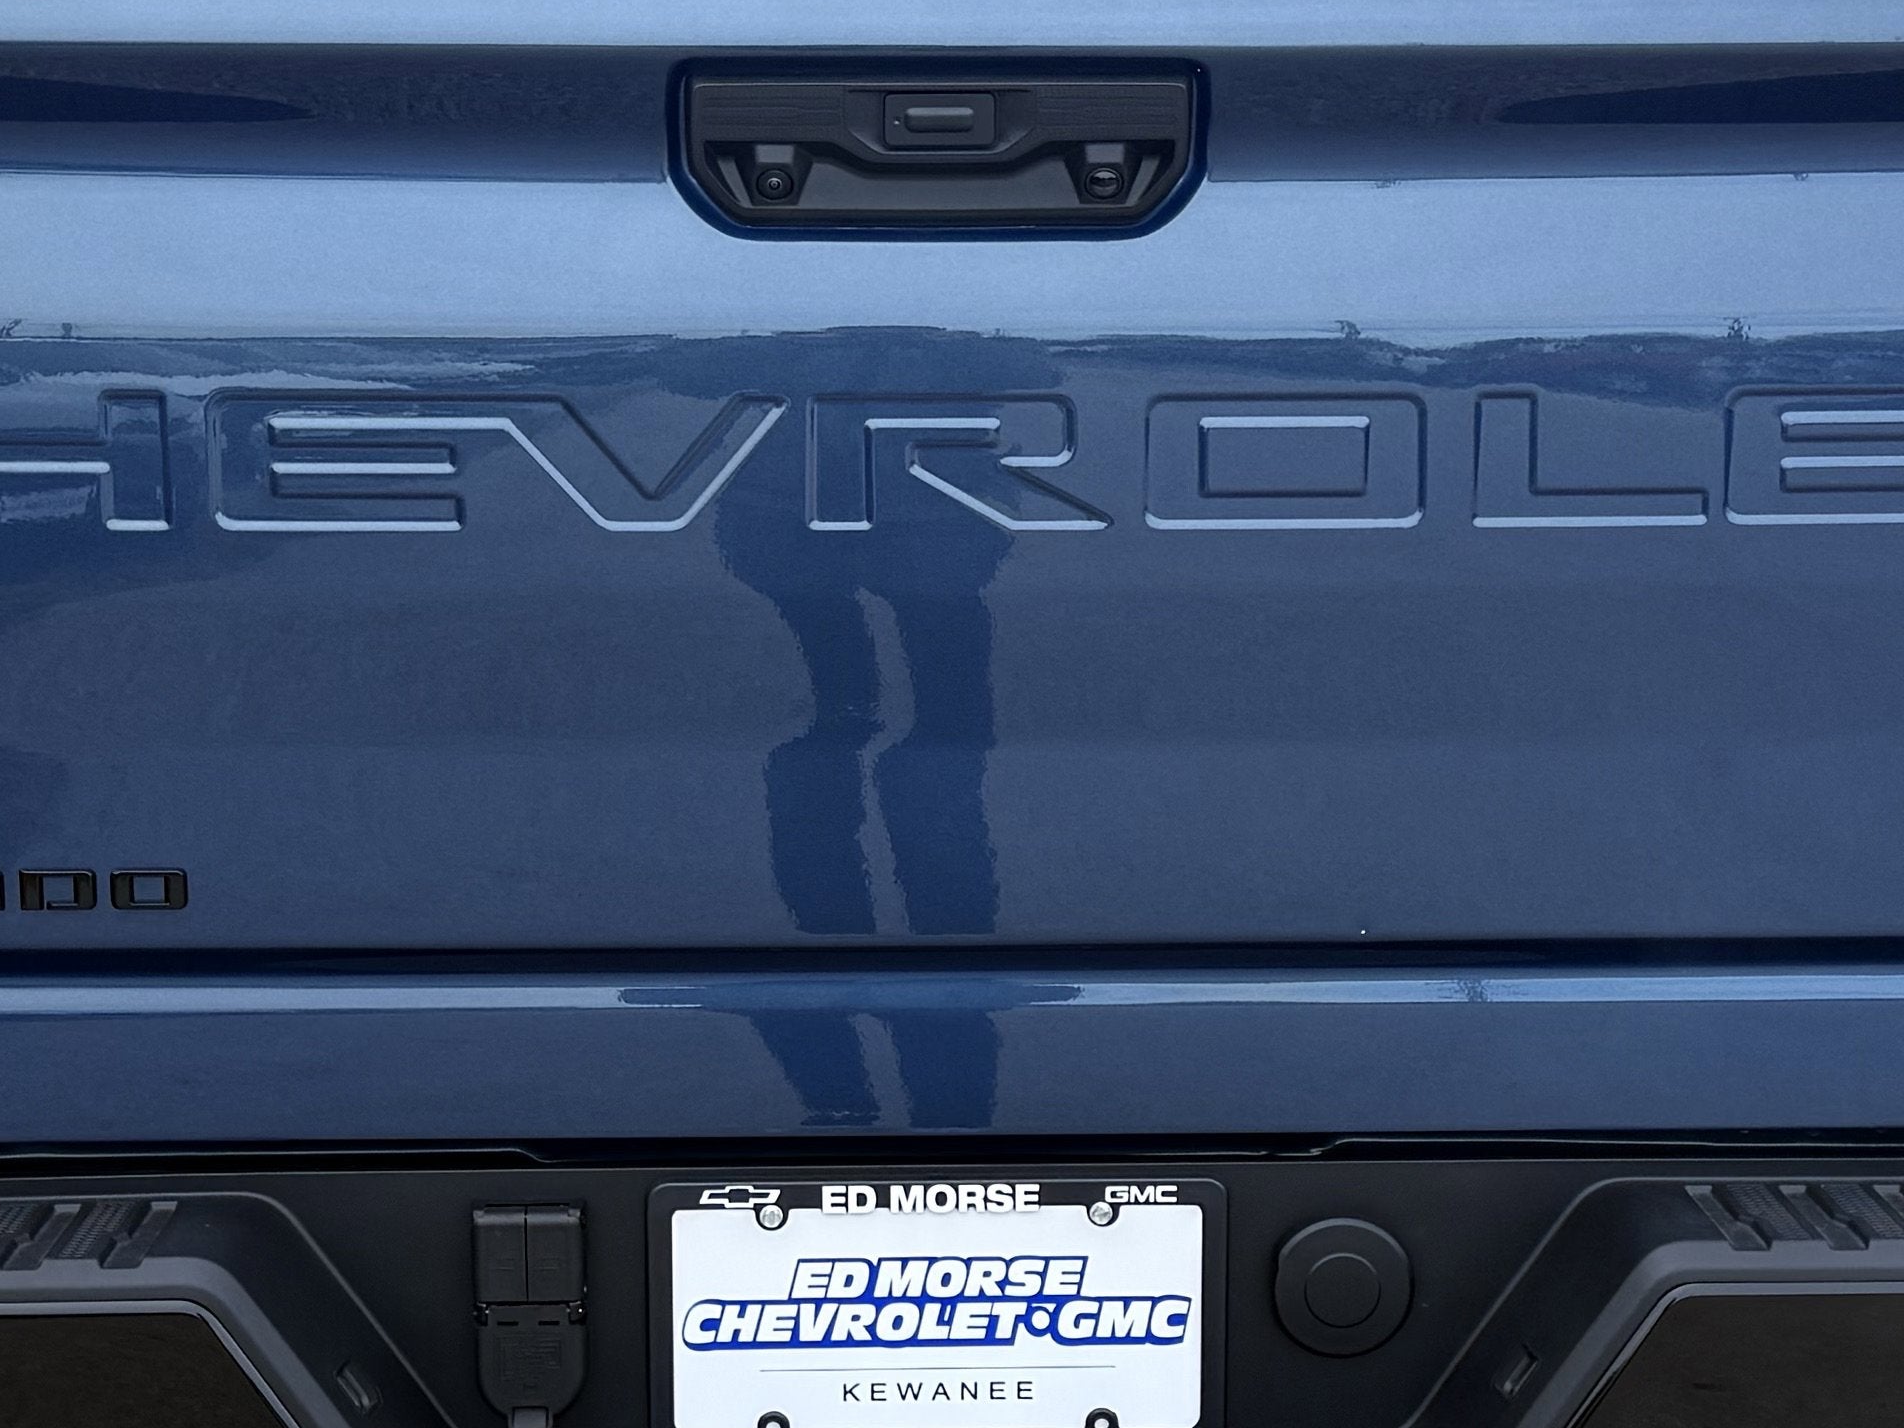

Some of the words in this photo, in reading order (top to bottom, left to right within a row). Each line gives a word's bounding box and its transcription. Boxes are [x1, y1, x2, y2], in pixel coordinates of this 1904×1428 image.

[821, 1184, 877, 1215] ED
[889, 1183, 1040, 1214] MORSE
[1104, 1185, 1178, 1203] GMC
[790, 1260, 871, 1299] ED
[873, 1258, 1084, 1299] MORSE
[842, 1381, 1034, 1402] KEWANEE
